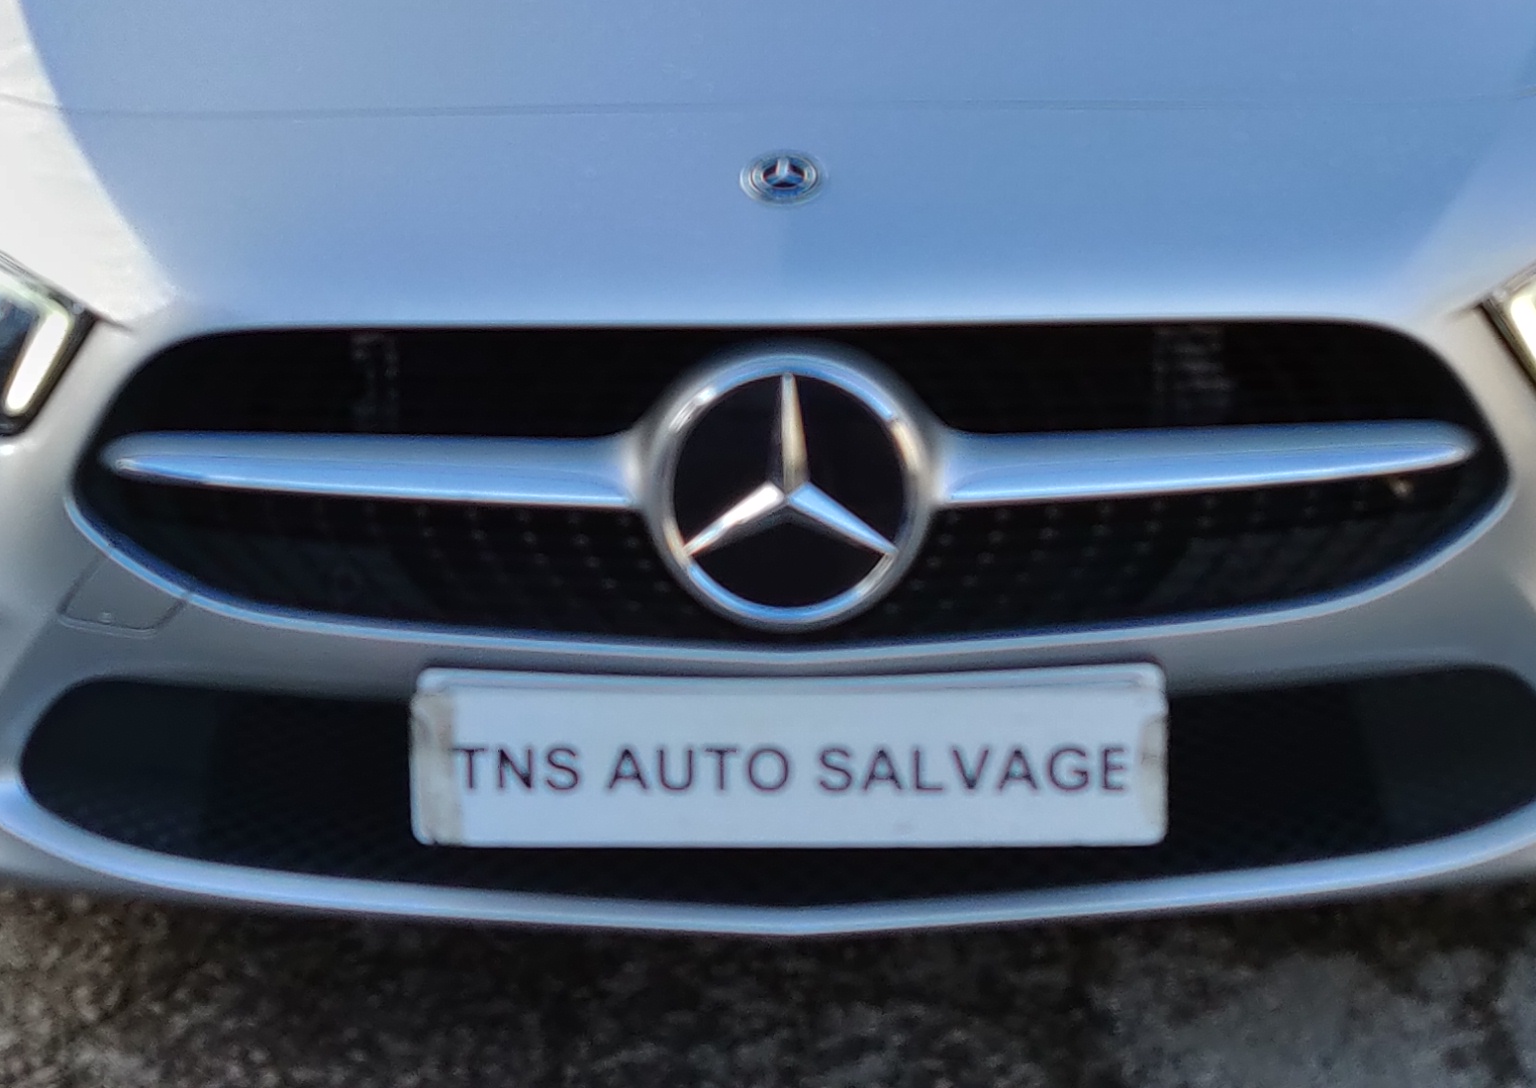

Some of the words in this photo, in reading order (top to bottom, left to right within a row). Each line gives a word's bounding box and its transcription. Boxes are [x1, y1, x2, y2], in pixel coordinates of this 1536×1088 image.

[452, 744, 580, 792] TNS
[607, 744, 792, 793] AUTO
[817, 744, 1129, 793] SALVAGE
